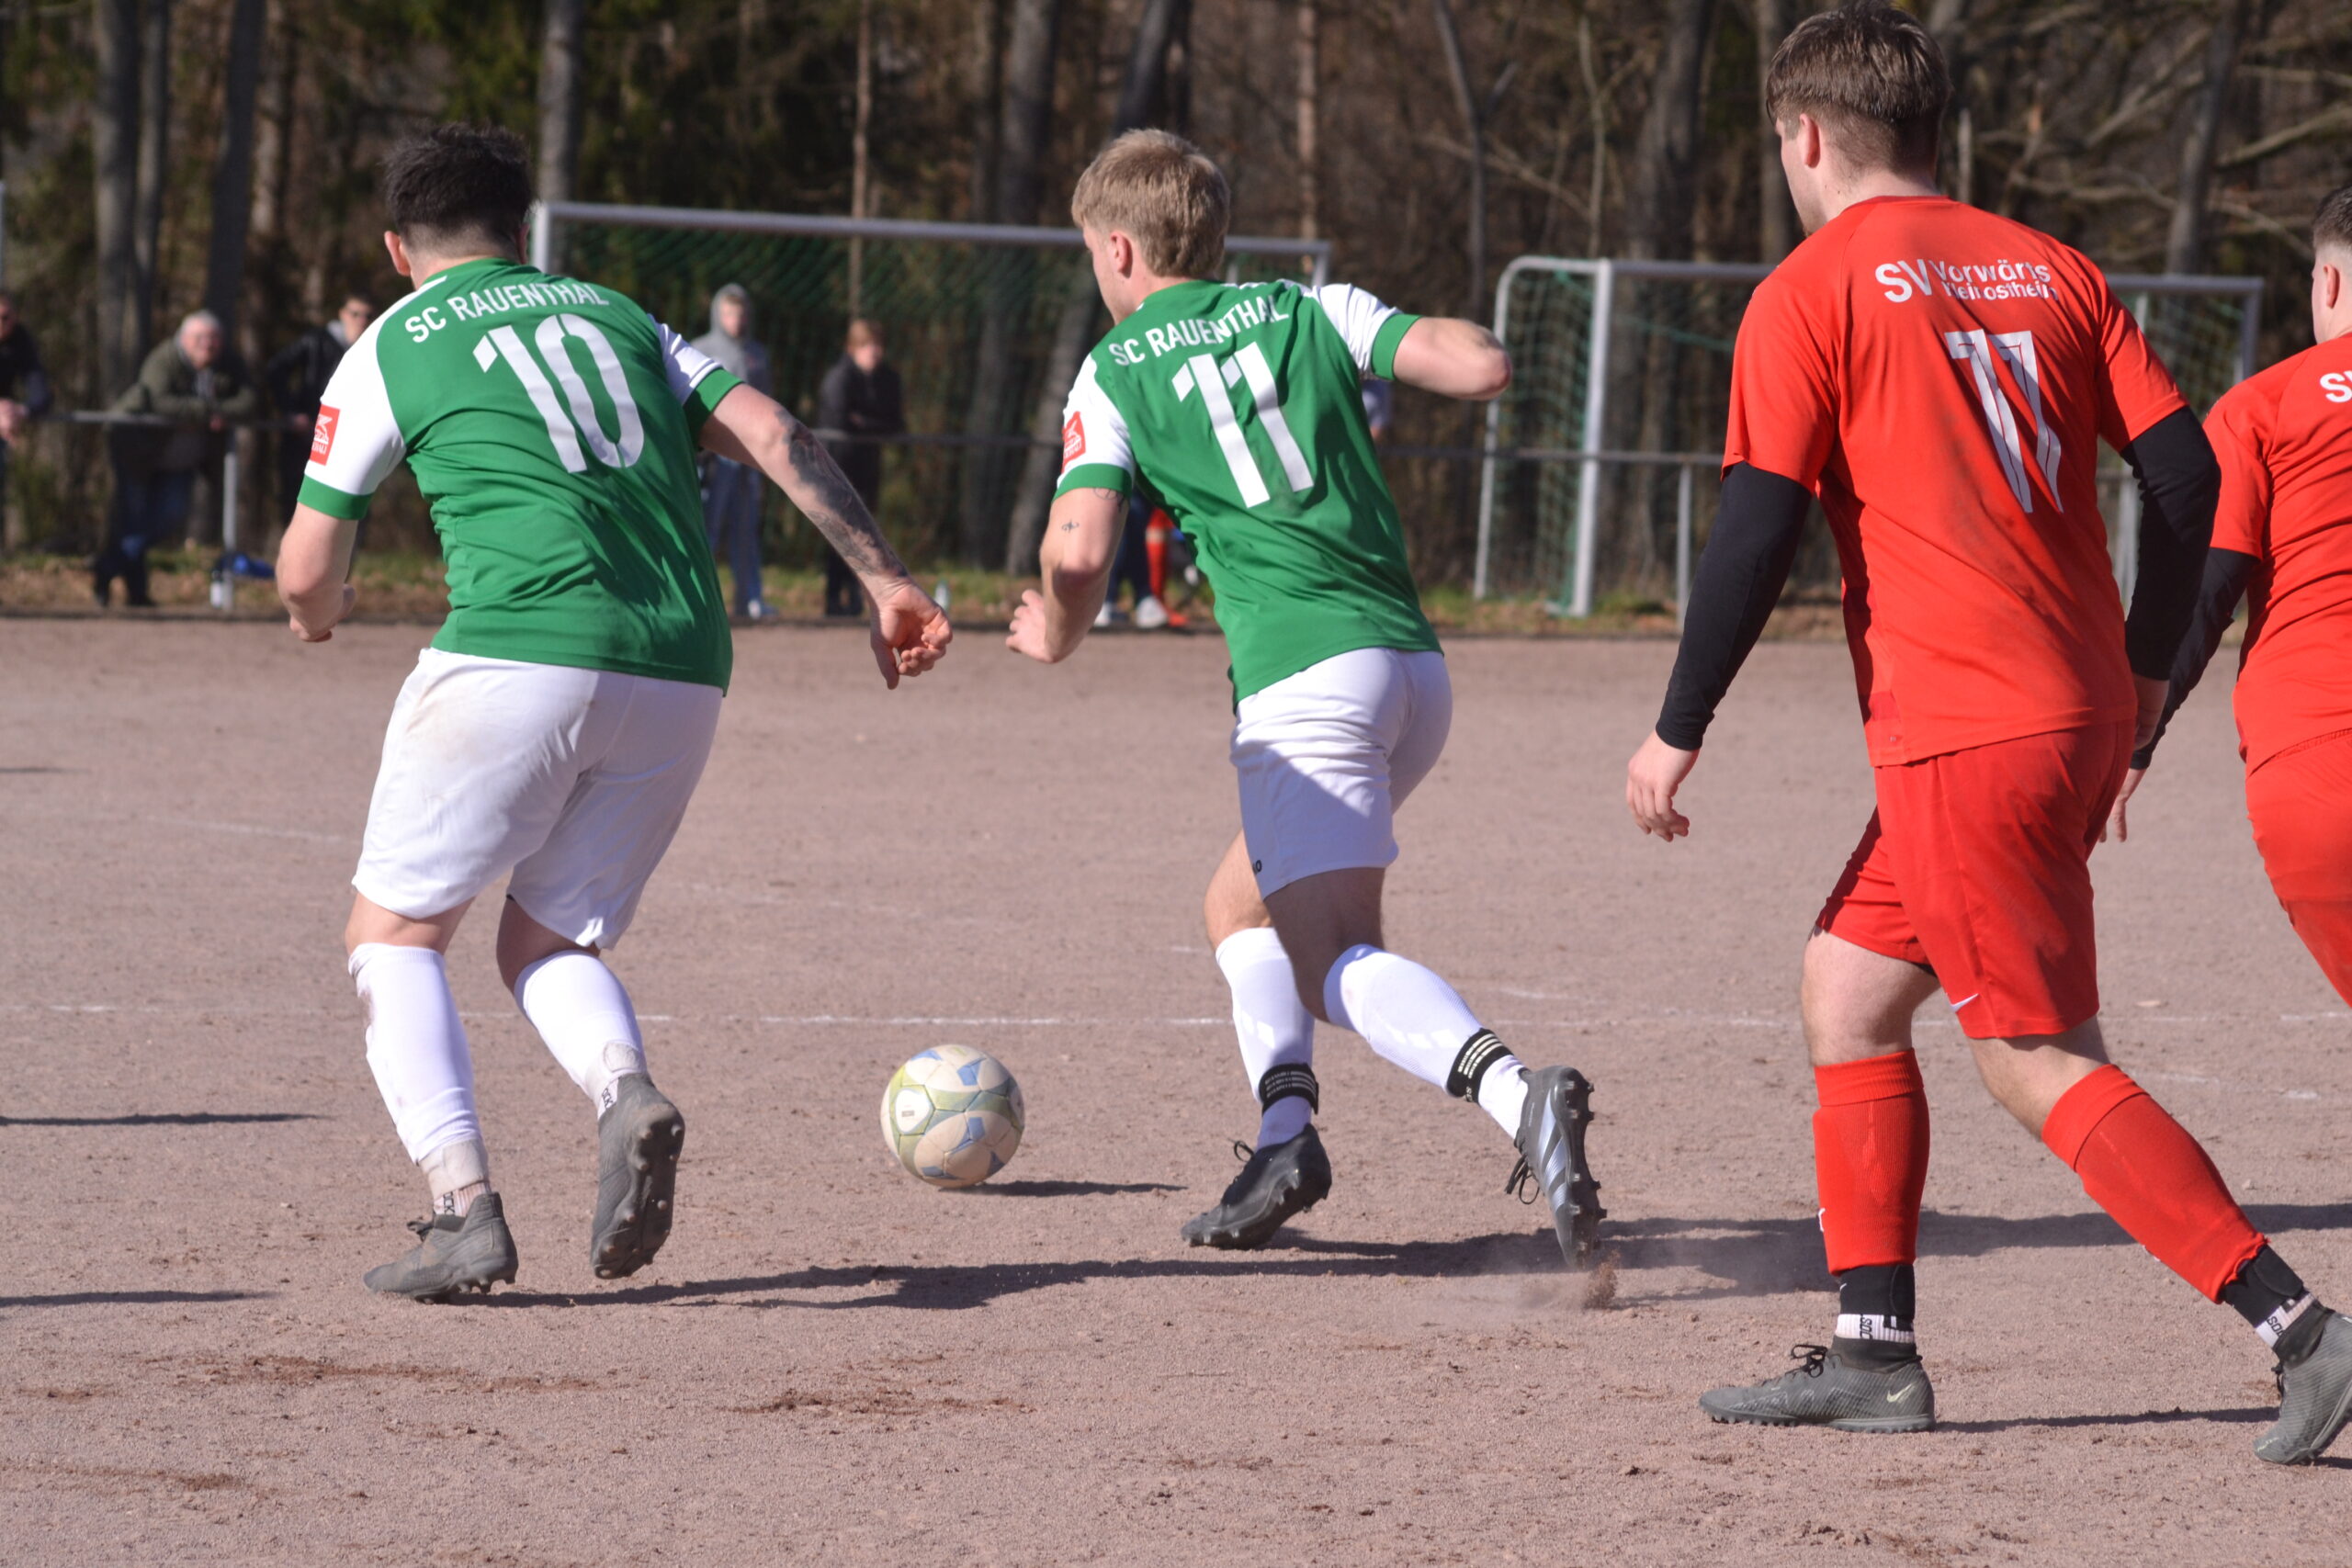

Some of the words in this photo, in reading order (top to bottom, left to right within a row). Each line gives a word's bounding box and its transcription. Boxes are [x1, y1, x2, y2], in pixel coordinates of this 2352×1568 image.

[404, 307, 447, 343] SC
[447, 283, 609, 321] RAUENTHAL
[1875, 259, 1932, 303] SV
[1928, 259, 2051, 282] Vorwärts
[1109, 338, 1145, 366] SC
[1146, 295, 1289, 357] RAUENTHAL
[472, 313, 644, 473] 10
[2319, 369, 2352, 403] S
[1171, 341, 1314, 509] 11
